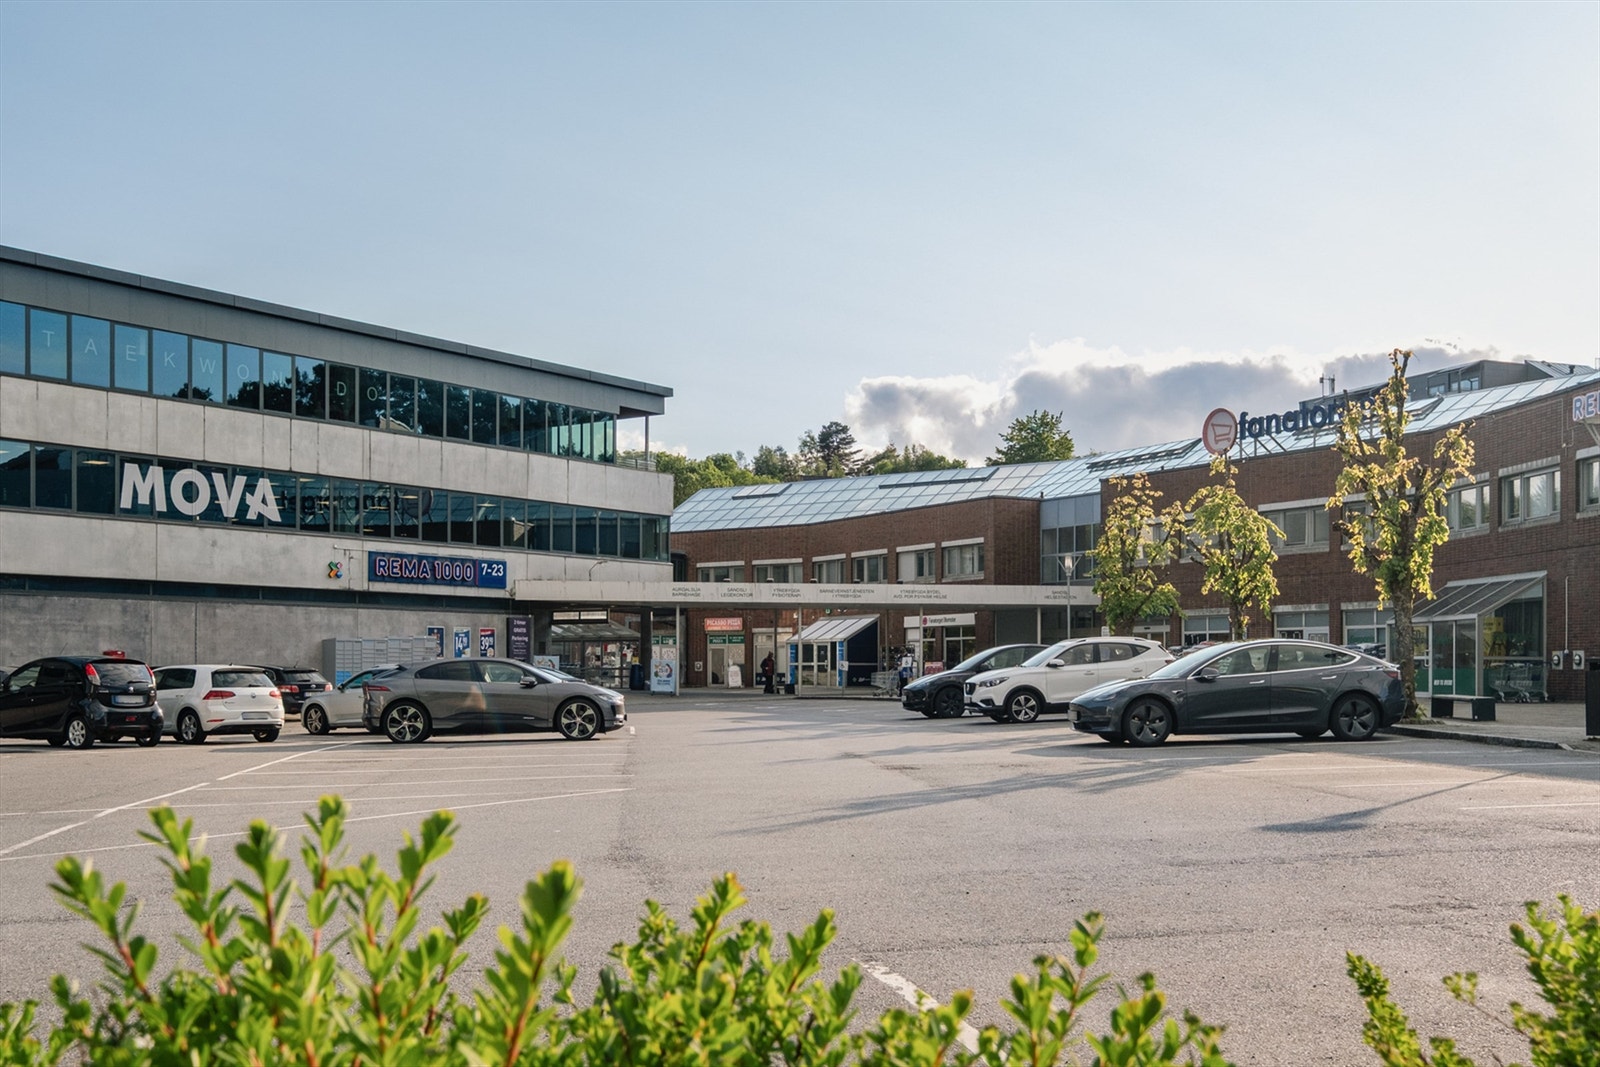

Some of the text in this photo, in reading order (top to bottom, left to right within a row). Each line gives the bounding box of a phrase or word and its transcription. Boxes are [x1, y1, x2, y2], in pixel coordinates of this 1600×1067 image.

[1573, 390, 1600, 421] RE
[120, 462, 282, 522] MOVA
[375, 557, 504, 581] REMA 1000 7-23
